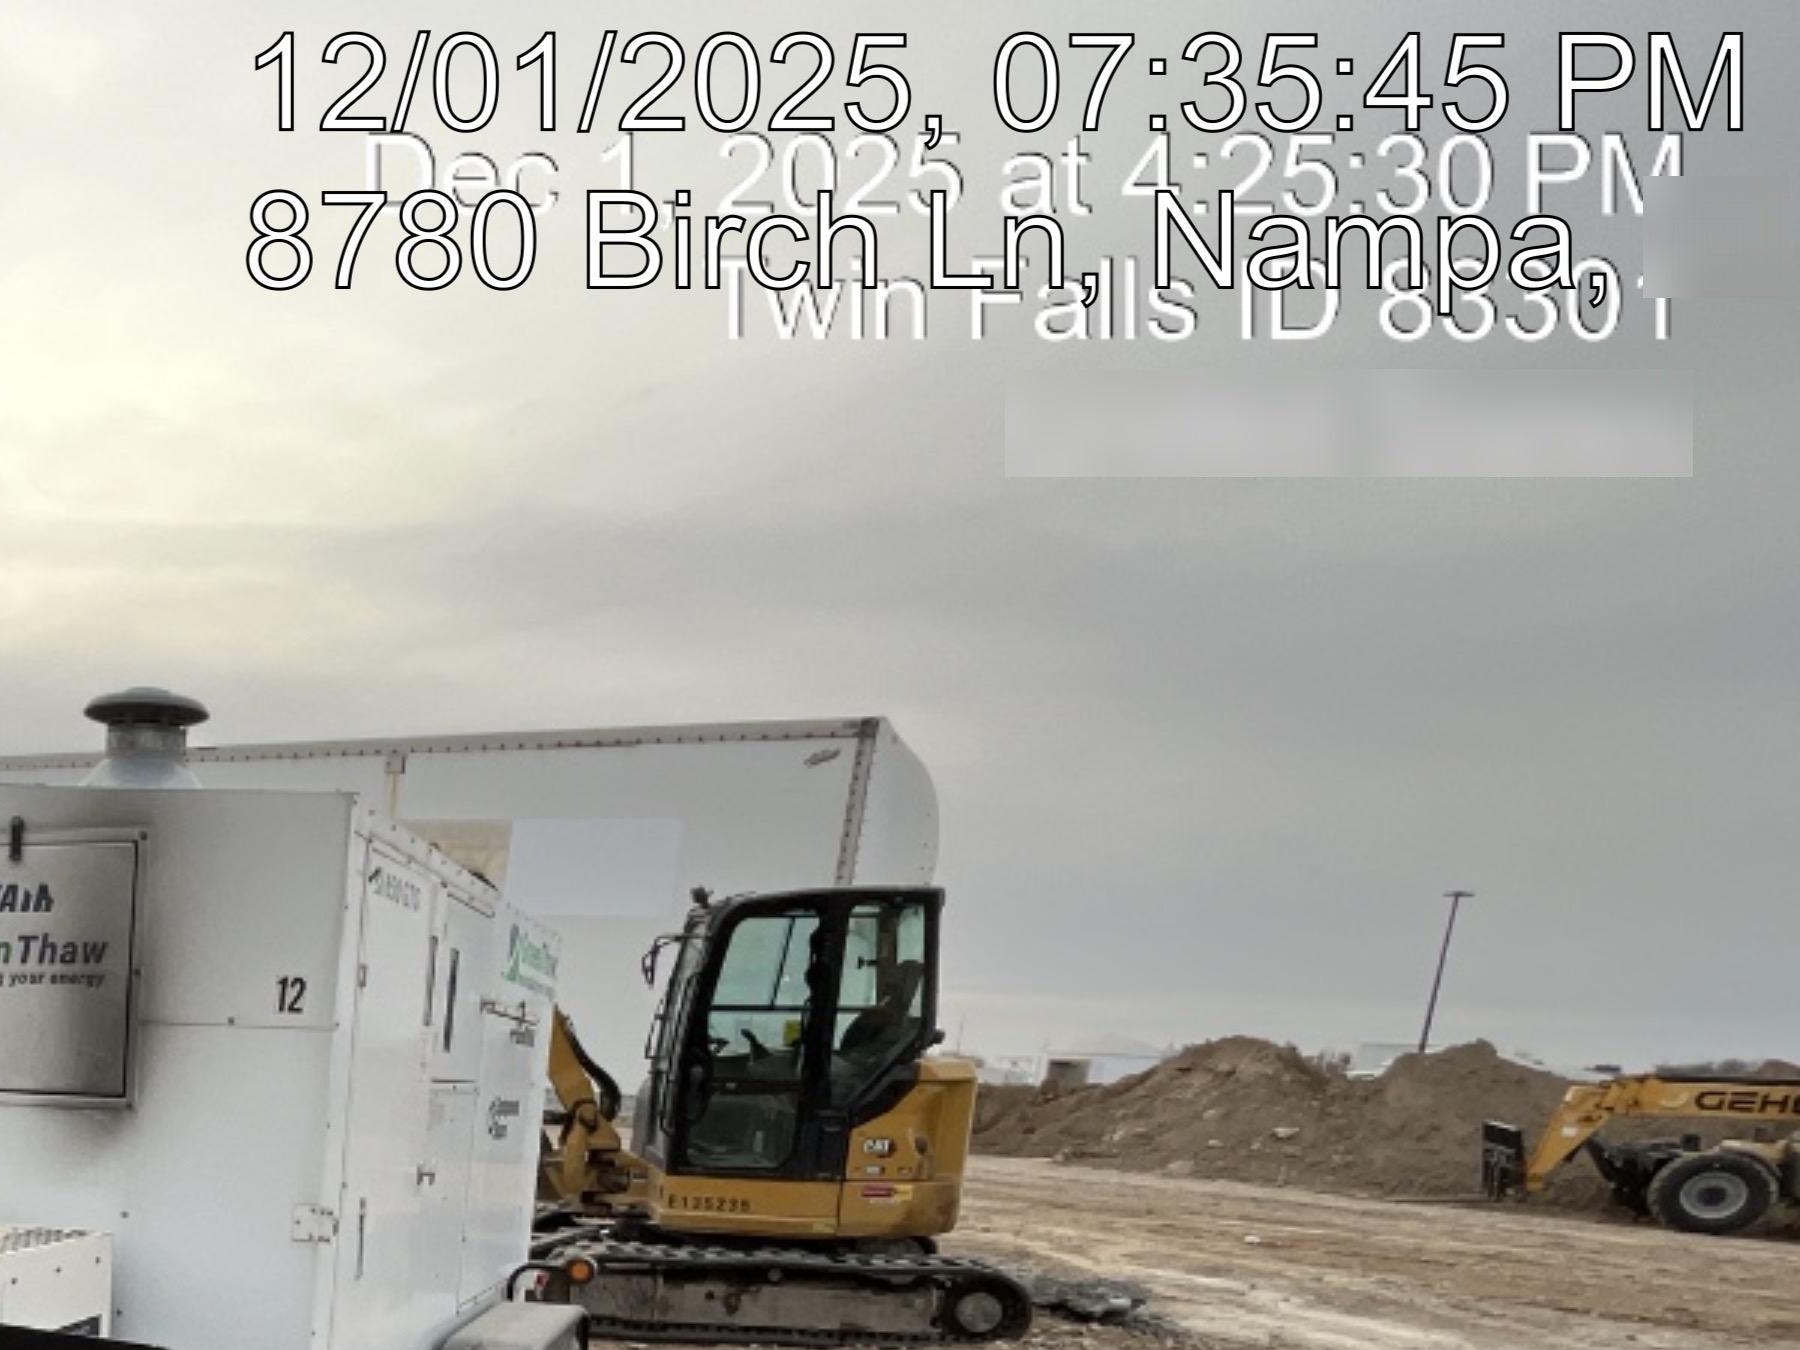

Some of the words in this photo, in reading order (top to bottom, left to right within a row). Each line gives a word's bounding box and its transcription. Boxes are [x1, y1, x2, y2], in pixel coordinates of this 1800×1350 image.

[8, 973, 45, 987] your
[277, 976, 307, 1014] 12
[863, 1138, 890, 1156] CAT
